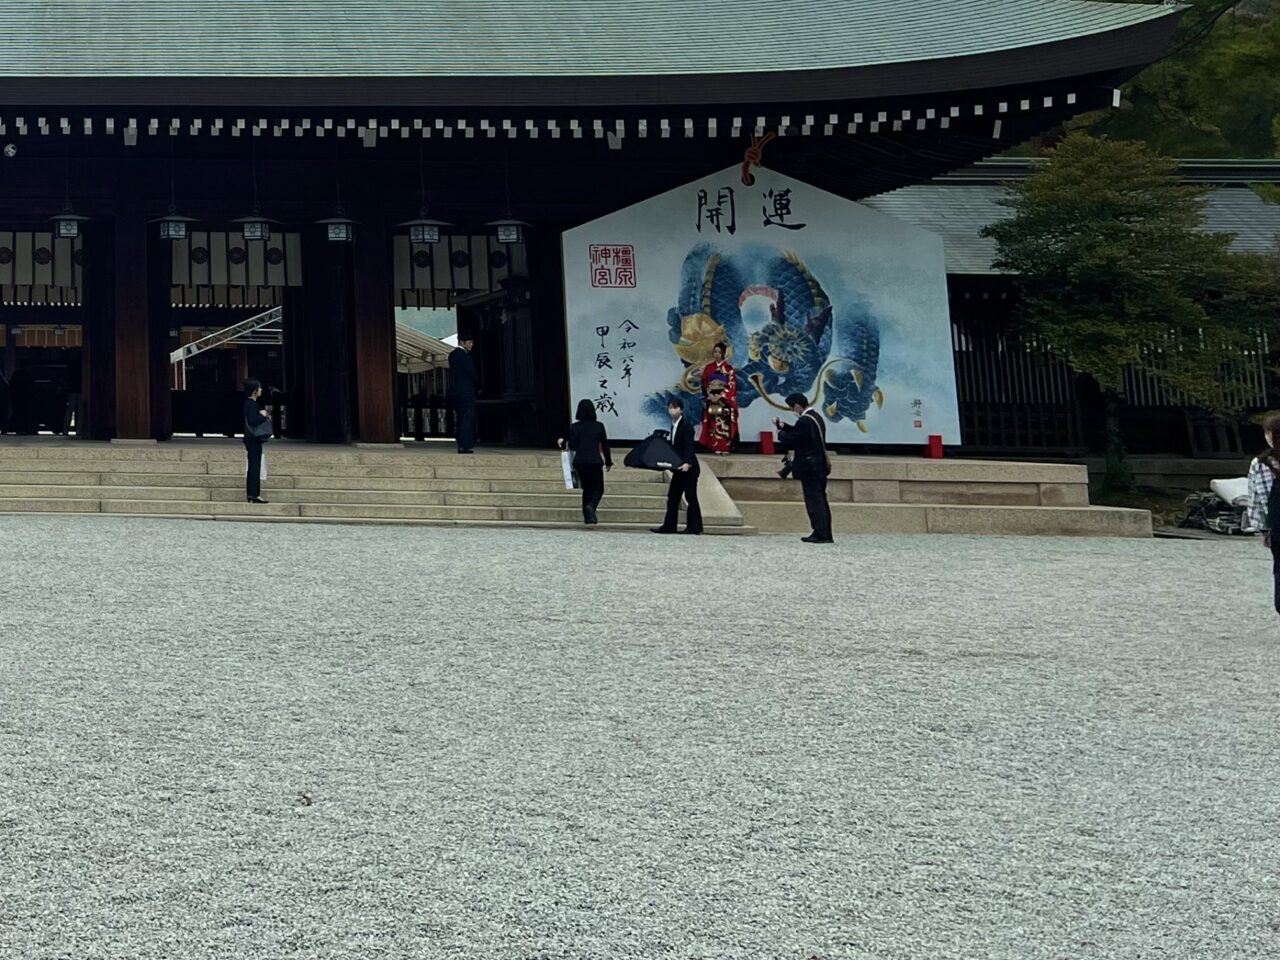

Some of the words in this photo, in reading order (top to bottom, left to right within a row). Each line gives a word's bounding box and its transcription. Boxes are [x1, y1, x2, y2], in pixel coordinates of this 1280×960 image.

[696, 186, 807, 235] 開運
[618, 319, 640, 388] 令和六年
